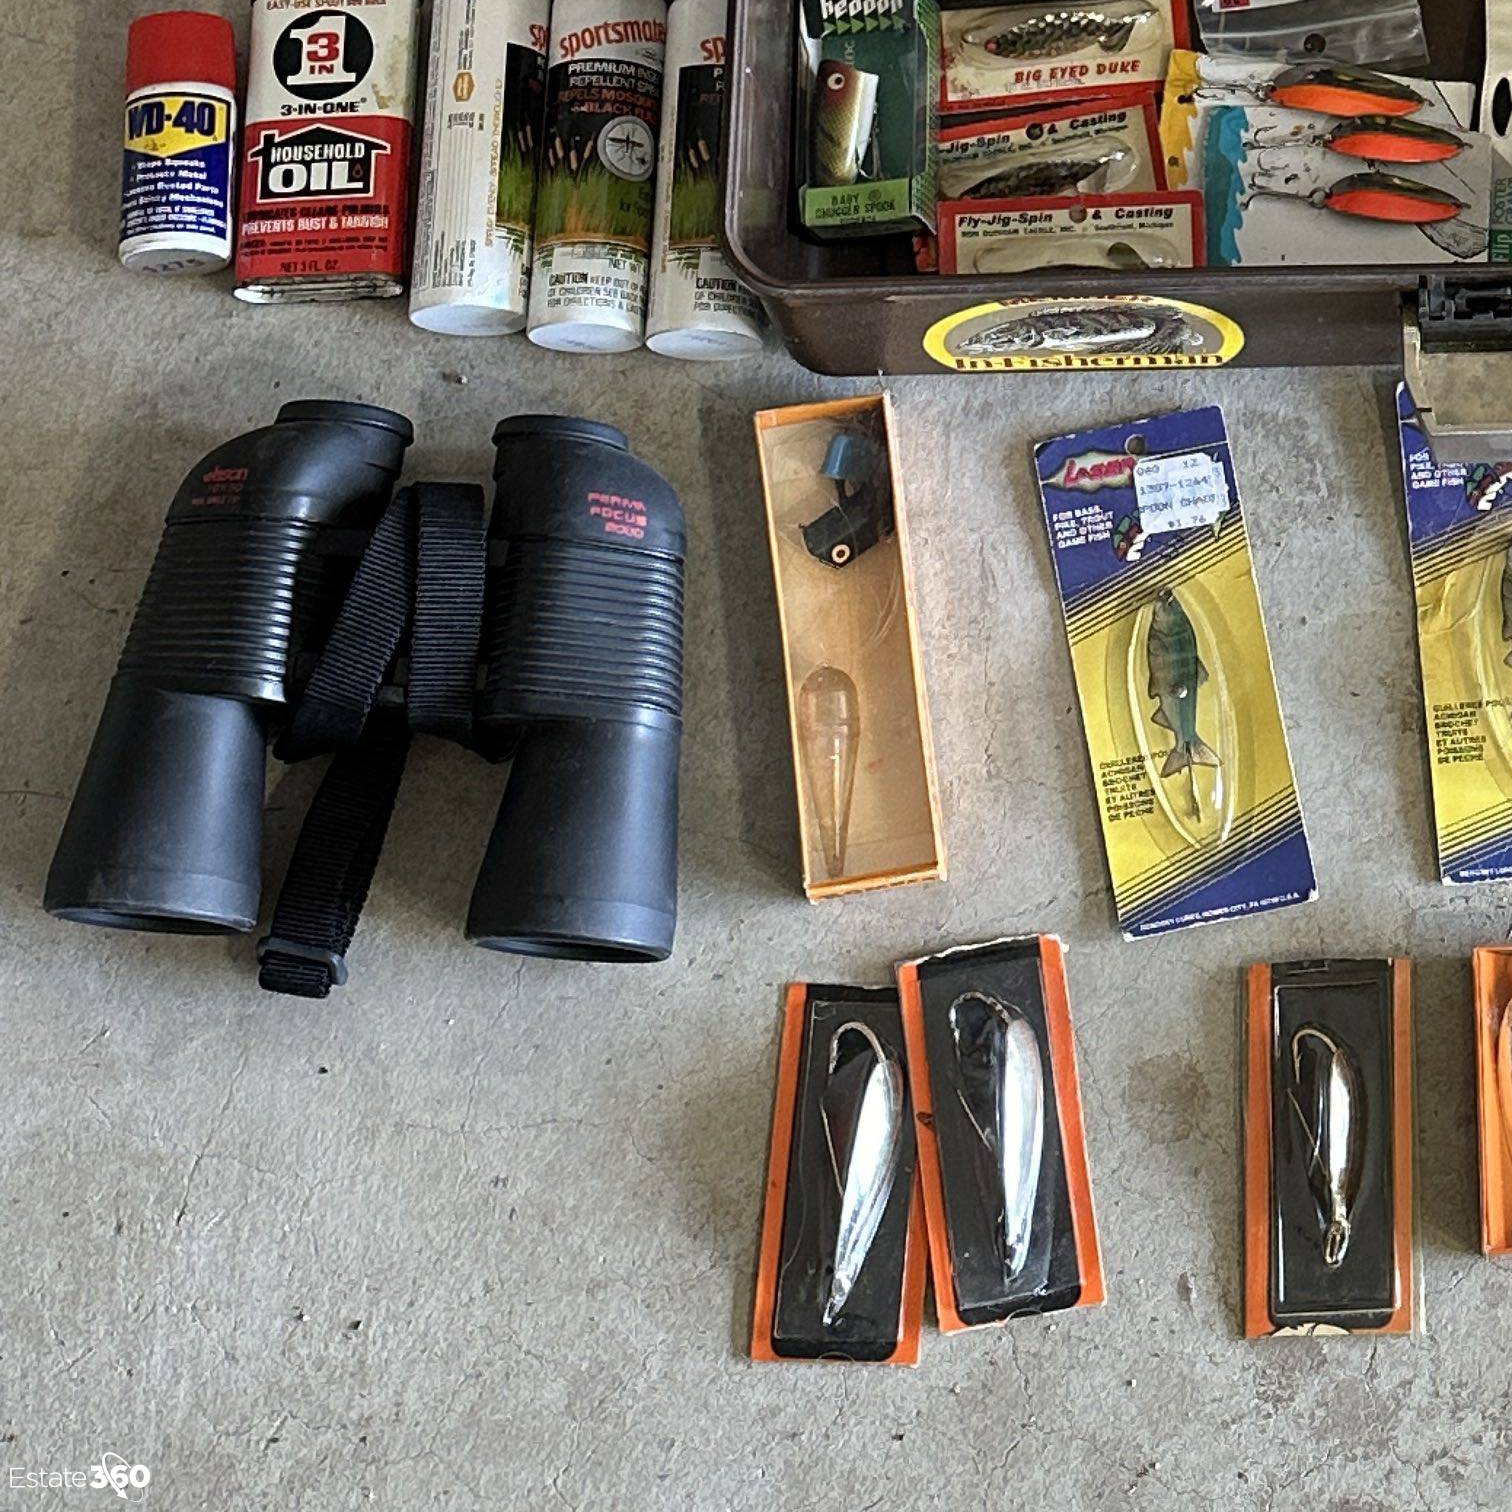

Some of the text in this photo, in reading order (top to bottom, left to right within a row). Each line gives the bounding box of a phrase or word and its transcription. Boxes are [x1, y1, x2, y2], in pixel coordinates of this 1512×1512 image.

[306, 32, 340, 62] 3
[309, 64, 334, 75] IN
[567, 61, 637, 78] PREMIUM
[1013, 69, 1043, 85] BIG
[1049, 64, 1089, 82] EYED
[1096, 59, 1142, 76] DUKE
[568, 74, 636, 89] REPELLENT
[128, 100, 217, 141] WD-40
[1069, 110, 1128, 132] Casting
[270, 142, 366, 164] HOUSEHOLD
[268, 161, 364, 194] OIL
[1493, 178, 1507, 225] FOSTER
[241, 219, 296, 237] PREVENTS
[297, 216, 328, 231] RUST
[329, 215, 339, 229] &
[341, 214, 390, 230] TARNISH
[957, 206, 1175, 228] Fly-Jig-Spin & Casting
[548, 271, 589, 286] CAUTION
[1411, 472, 1432, 481] AND
[1412, 480, 1441, 490] GAME
[589, 506, 648, 527] FOCUS
[1052, 511, 1073, 522] FOR
[1081, 511, 1114, 526] TROUT
[1056, 521, 1114, 540] AND OTHER
[1058, 529, 1111, 549] GAME FISH
